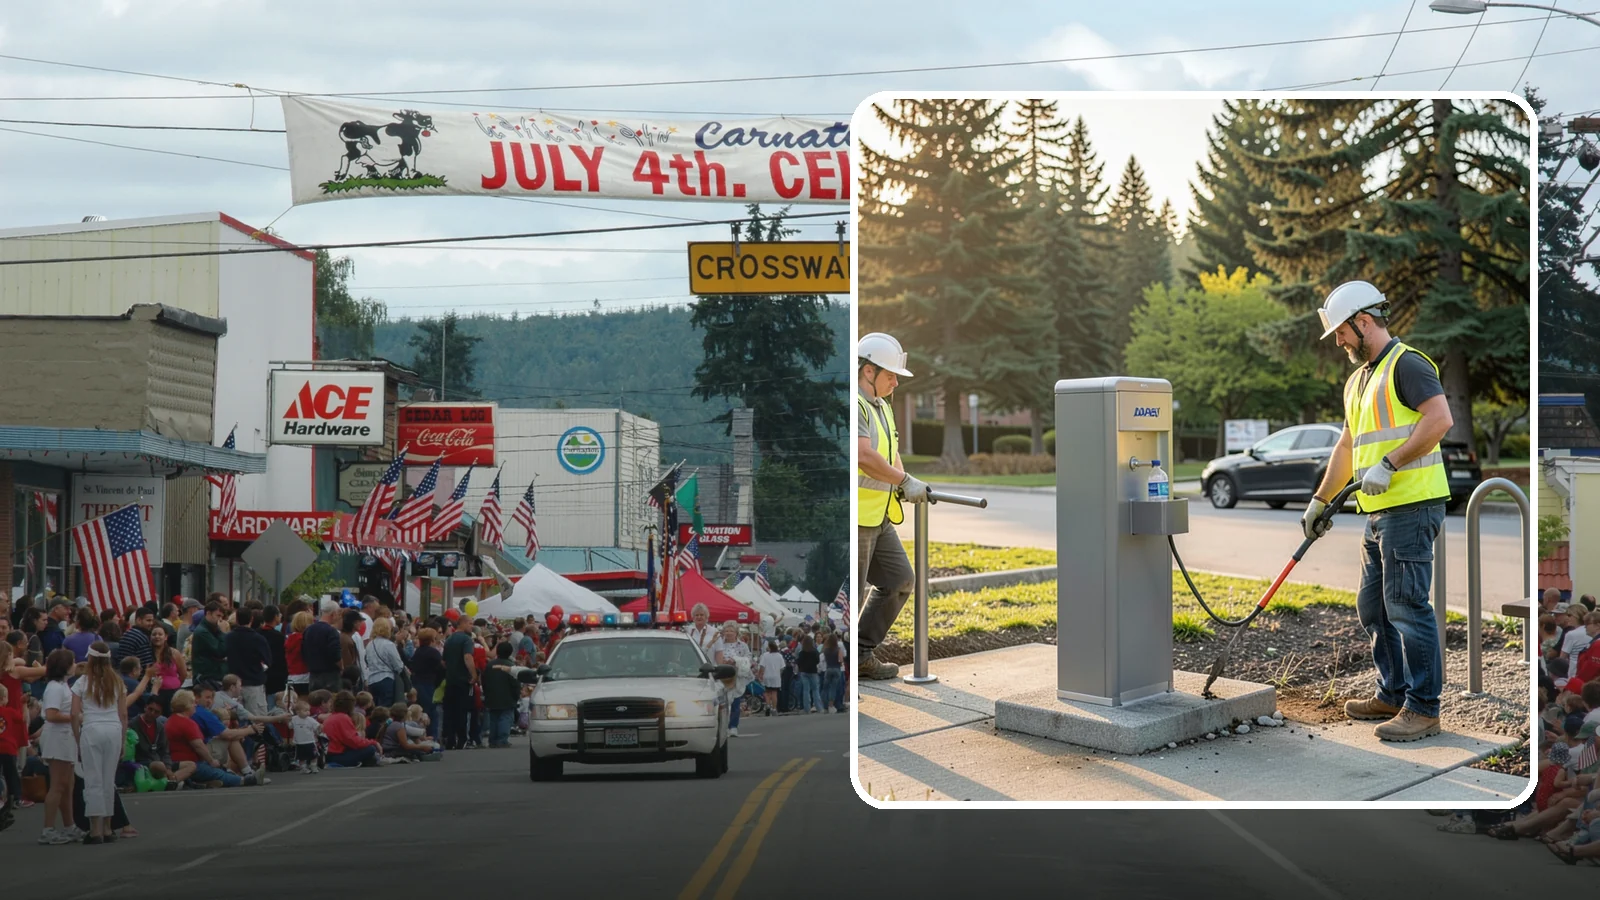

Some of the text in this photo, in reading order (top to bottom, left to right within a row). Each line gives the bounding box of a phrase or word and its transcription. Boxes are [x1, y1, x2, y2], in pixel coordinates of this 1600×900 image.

[695, 121, 850, 149] Carnat
[481, 141, 605, 192] JULY
[632, 150, 746, 198] 4th.
[697, 254, 850, 280] CROSSWA
[282, 380, 373, 420] ACE
[405, 409, 485, 422] CEDAR LOG
[283, 421, 371, 437] Hardware
[353, 467, 384, 479] Simpl
[95, 485, 124, 494] Vincent
[126, 486, 136, 494] de
[137, 485, 155, 495] Paul
[688, 526, 741, 535] CRNATION
[699, 535, 730, 543] GLASS
